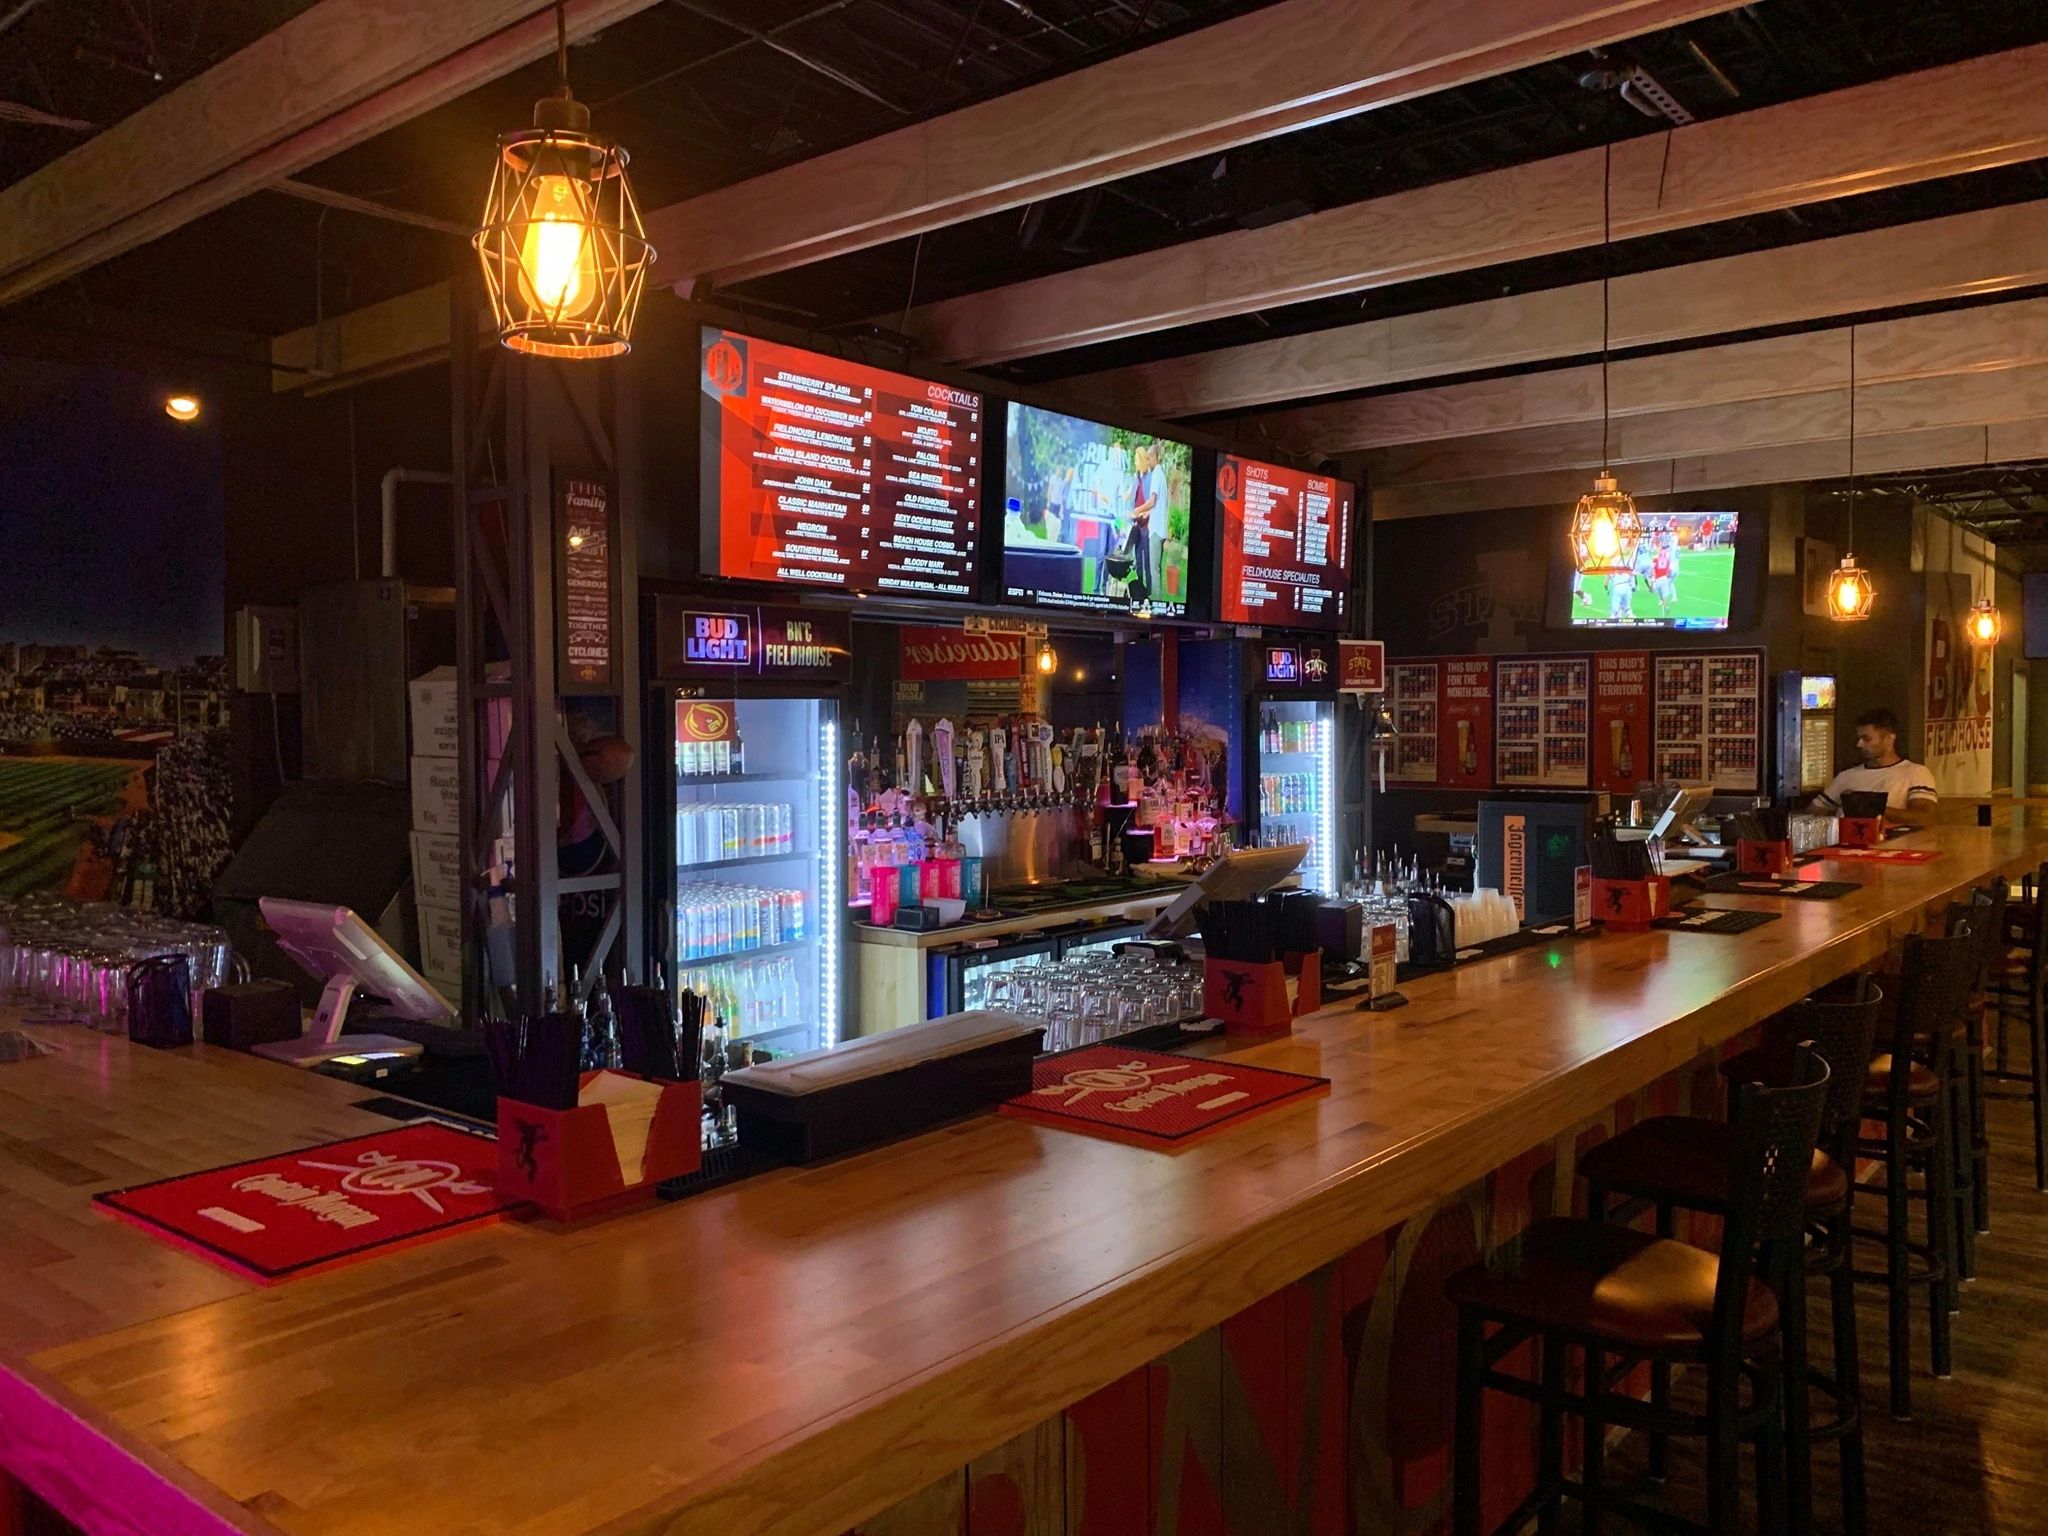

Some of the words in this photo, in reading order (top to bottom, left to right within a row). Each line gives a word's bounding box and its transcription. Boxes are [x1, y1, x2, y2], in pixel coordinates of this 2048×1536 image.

[778, 372, 824, 388] STRAWBERRY
[824, 382, 850, 395] SPLASH
[927, 385, 979, 407] COCKTAILS
[761, 396, 804, 411] WATERMELON
[805, 405, 814, 413] OR
[815, 408, 847, 420] CUCUMBER
[848, 414, 864, 423] MULE
[910, 404, 923, 413] TOM
[923, 408, 947, 419] COLLINS
[774, 423, 816, 438] FIELDHOUSE
[817, 432, 852, 445] LEMONADE
[917, 426, 938, 436] MOJITO
[775, 447, 794, 457] LONG
[795, 450, 820, 461] ISLAND
[820, 455, 851, 467] COCKTAIL
[916, 451, 940, 462] PALOMA
[908, 471, 920, 479] SEA
[920, 472, 943, 483] BREEZE
[1246, 465, 1268, 480] SHOTS
[570, 481, 606, 496] THIS
[795, 476, 814, 486] JOHN
[815, 479, 832, 488] DALY
[1307, 479, 1328, 493] BOMBS
[567, 493, 606, 512] Family
[778, 496, 807, 507] CLASSIC
[808, 500, 847, 512] MANHATTAN
[904, 494, 917, 502] OLD
[918, 496, 949, 508] FASHIONED
[797, 522, 827, 533] NEGRONI
[895, 514, 911, 522] SEXY
[911, 516, 931, 525] OCEAN
[932, 518, 954, 528] SUNSET
[893, 535, 914, 544] BEACH
[915, 537, 934, 547] HOUSE
[934, 541, 955, 550] COSMO
[785, 544, 822, 555] SOUTHERN
[822, 548, 838, 557] BELL
[904, 557, 928, 567] BLOODY
[928, 560, 944, 569] MARY
[777, 568, 789, 576] ALL
[790, 569, 806, 577] WELL
[806, 570, 837, 579] COCKTAILS
[1242, 565, 1282, 580] FIELDHOUSE
[567, 579, 607, 589] GENEROUS
[878, 577, 900, 586] MONDAY
[900, 580, 914, 588] MULE
[914, 581, 935, 590] SPECIAL
[568, 621, 607, 631] TOGETHER
[695, 617, 738, 638] BUD
[989, 616, 1027, 631] CYCLONES
[568, 645, 608, 658] CYCLONES
[687, 637, 747, 660] LIGHT
[765, 644, 832, 667] FIELDHOUSE
[1272, 651, 1291, 665] BUD
[1348, 655, 1372, 671] STATE
[1598, 657, 1617, 669] THIS
[1619, 656, 1645, 669] BUD'S
[1268, 664, 1296, 678] LIGHT
[1304, 658, 1329, 675] STATE
[1447, 662, 1464, 673] THIS
[1465, 661, 1488, 673] BUD'S
[1447, 674, 1462, 685] FOR
[1463, 674, 1478, 685] THE
[1598, 671, 1615, 683] FOR
[1447, 686, 1472, 698] NORTH
[1598, 684, 1645, 696] TERRITORY.
[994, 733, 1005, 744] IPA
[1925, 720, 1991, 757] FIELDHOUSE
